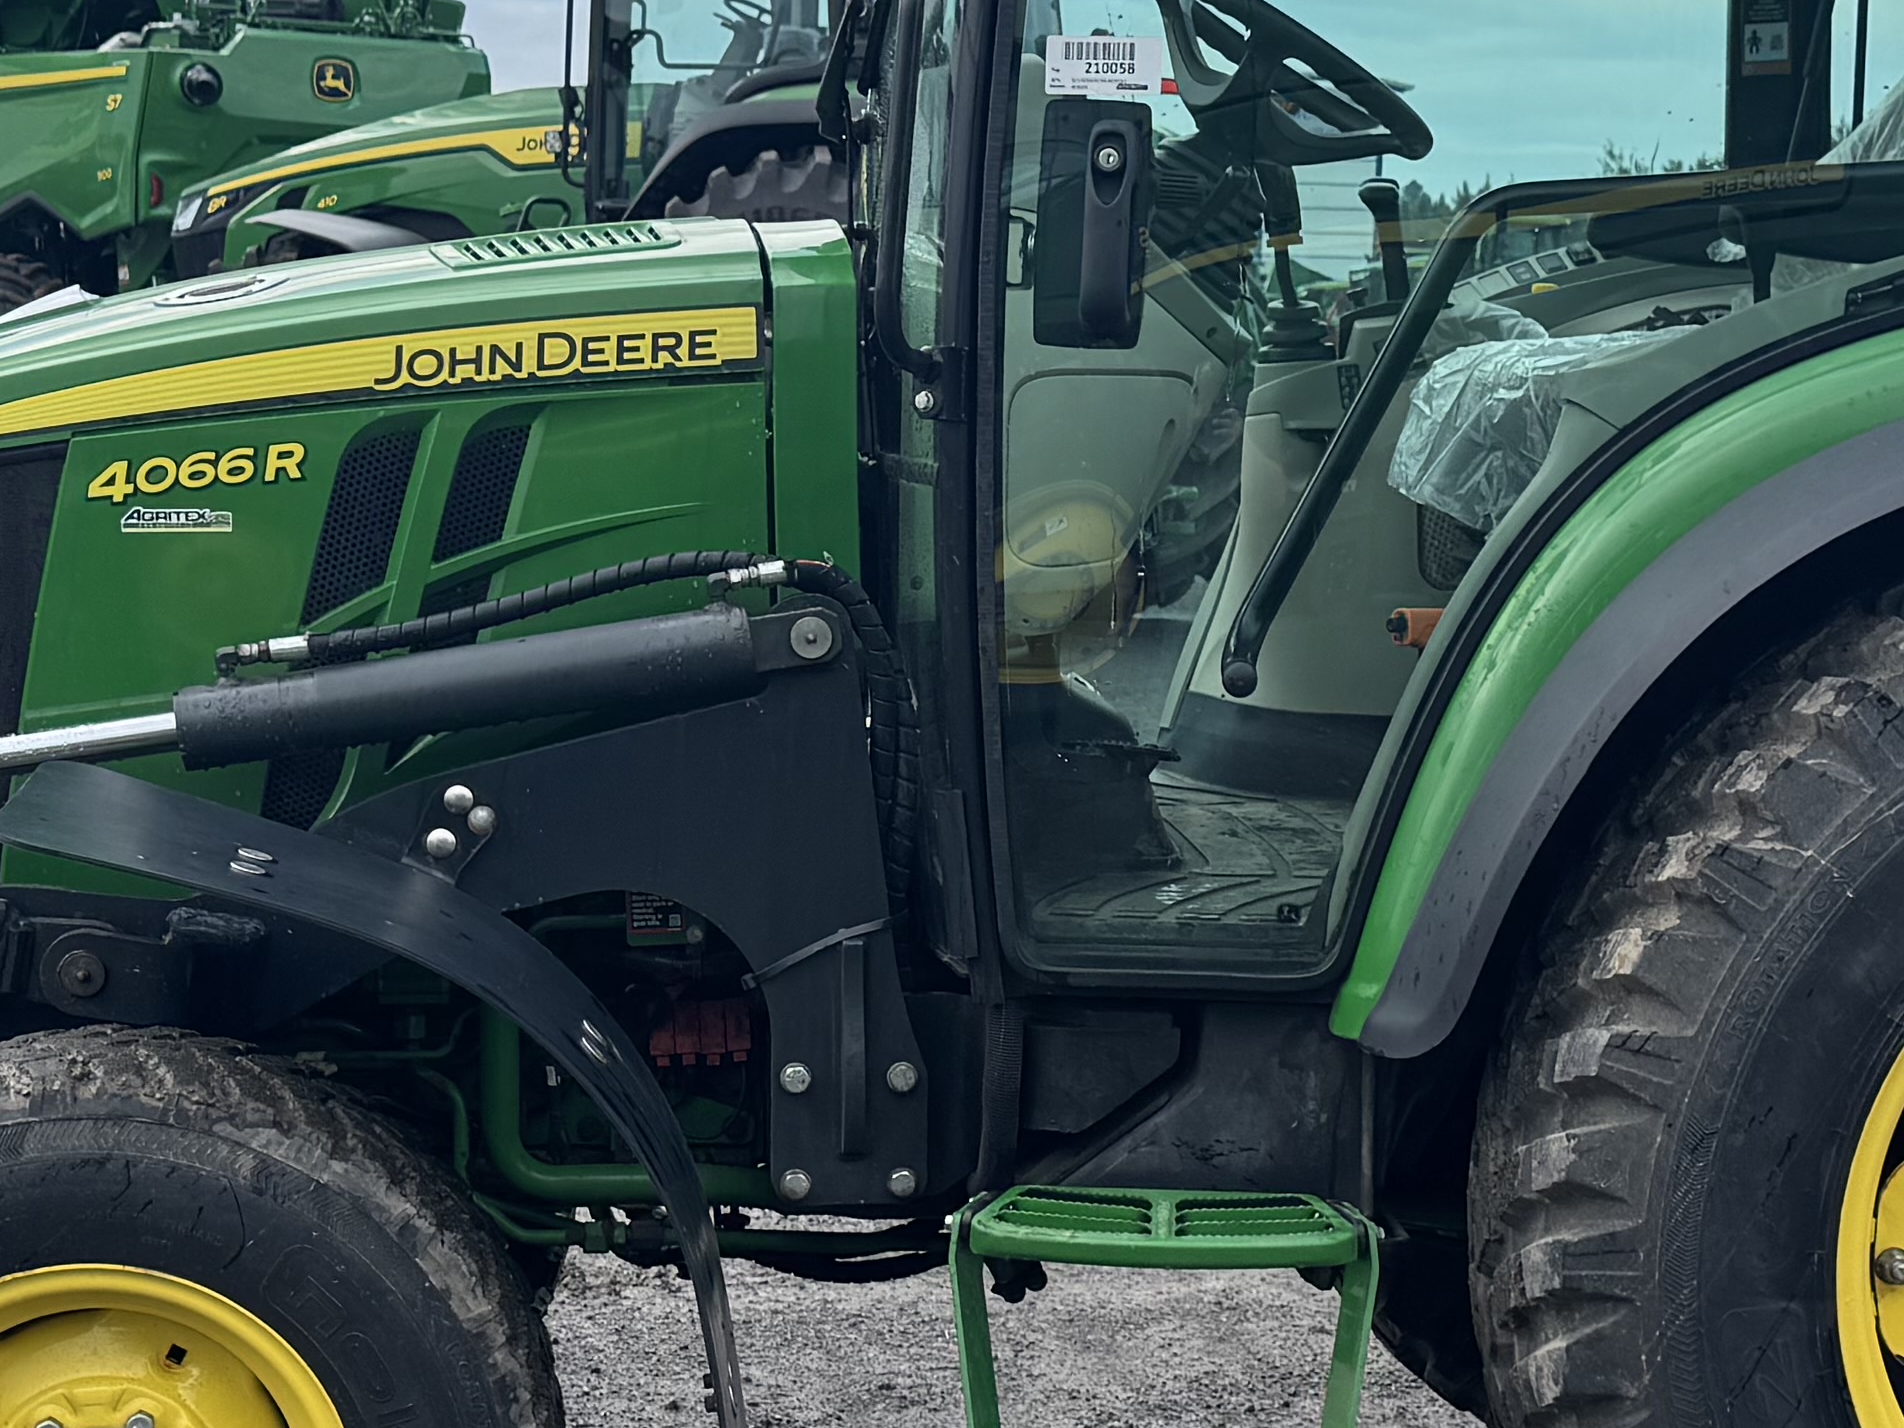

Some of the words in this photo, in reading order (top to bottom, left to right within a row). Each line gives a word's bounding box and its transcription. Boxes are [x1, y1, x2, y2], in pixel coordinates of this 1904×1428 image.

[1085, 62, 1135, 75] 210058
[373, 341, 524, 387] JOHN
[537, 328, 718, 372] DEERE
[123, 508, 209, 523] AGRITEX
